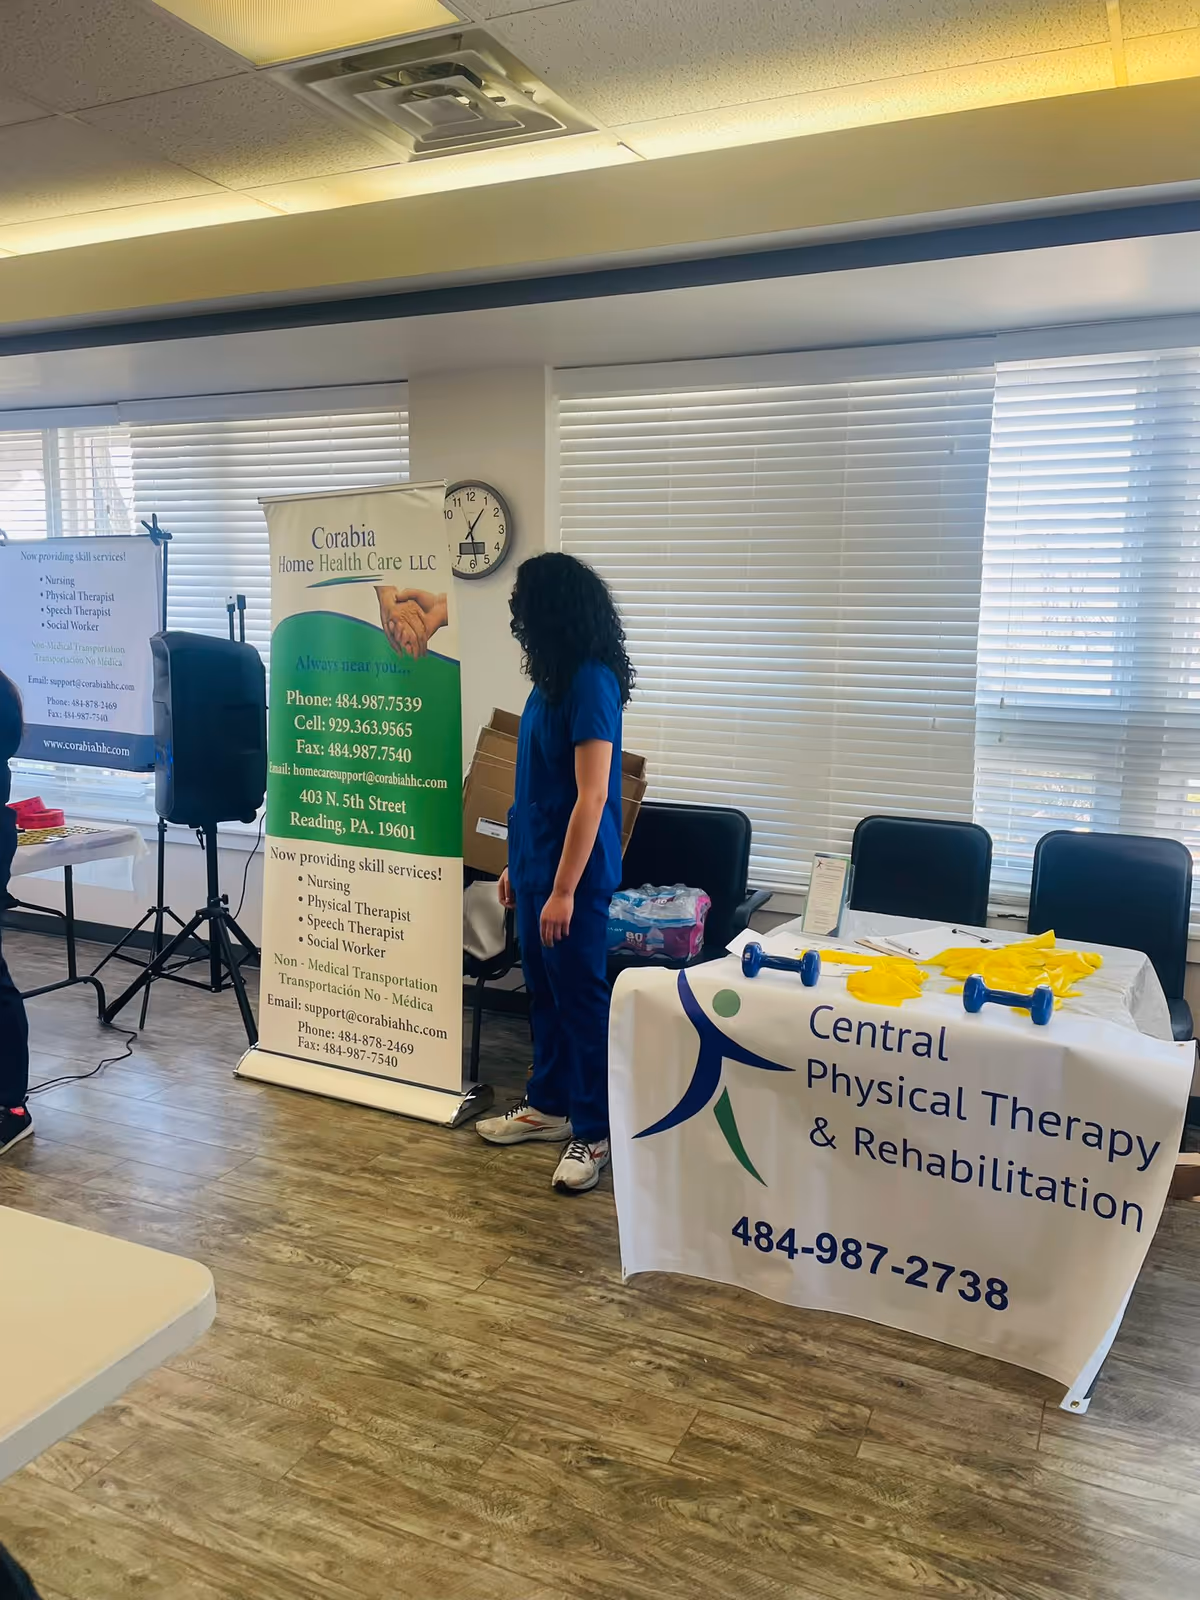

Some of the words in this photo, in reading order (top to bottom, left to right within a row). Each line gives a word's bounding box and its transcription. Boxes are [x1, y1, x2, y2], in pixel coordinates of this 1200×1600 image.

[453, 498, 461, 507] 11
[466, 492, 475, 501] 12
[484, 497, 487, 505] 1
[444, 510, 453, 519] 10
[494, 507, 499, 517] 2
[312, 524, 375, 549] Corabia
[499, 525, 504, 534] 3
[494, 542, 500, 551] 4
[21, 551, 38, 561] Now
[39, 551, 74, 564] providing
[75, 551, 91, 561] skill
[93, 552, 126, 562] services!
[279, 556, 313, 573] Home
[320, 552, 362, 572] Health
[367, 552, 401, 570] Care
[410, 555, 436, 571] LLC
[456, 555, 462, 565] 7
[470, 560, 476, 569] 6
[484, 555, 490, 564] 5
[45, 575, 75, 587] Nursing
[46, 591, 76, 604] Physical
[78, 592, 114, 604] Therapist
[46, 605, 72, 618] Speech
[74, 606, 111, 619] Therapist
[47, 621, 69, 630] Social
[70, 622, 99, 631] Worker
[85, 656, 96, 665] No
[296, 655, 338, 671] Always
[342, 661, 370, 672] near
[28, 675, 49, 685] Email:
[50, 676, 134, 691] support@corabiahhc.com
[47, 696, 70, 706] Phone:
[72, 699, 117, 710] 484-878-2469
[286, 690, 332, 707] Phone:
[335, 694, 422, 712] 484.987.7539
[48, 709, 62, 718] Fax:
[294, 715, 325, 731] Cell:
[329, 718, 412, 737] 929.363.9565
[43, 739, 129, 756] www.corabiahhc.com
[296, 739, 324, 755] Fax:
[328, 742, 411, 763] 484.987.7540
[270, 762, 290, 775] Email:
[293, 763, 447, 789] homecaresupport@corabiahhc.com
[299, 789, 322, 804] 403
[326, 791, 339, 806] N.
[343, 793, 364, 809] 5th
[369, 795, 406, 813] Street
[290, 812, 346, 835] Reading,
[350, 818, 374, 834] PA.
[379, 821, 415, 840] 19601
[271, 846, 296, 861] Now
[300, 852, 355, 873] providing
[359, 858, 384, 873] skill
[388, 866, 442, 881] services!
[307, 874, 350, 895] Nursing
[308, 894, 351, 913] Physical
[355, 902, 411, 922] Therapist
[307, 914, 344, 932] Speech
[348, 920, 404, 941] Therapist
[307, 934, 339, 950] Social
[342, 939, 386, 958] Worker
[274, 953, 297, 967] Non
[308, 958, 349, 977] Medical
[352, 966, 438, 993] Transportation
[279, 972, 360, 998] Transportación
[364, 988, 381, 1002] No
[392, 993, 433, 1012] Médica
[267, 994, 301, 1010] Email:
[304, 1002, 447, 1039] support@corabiahhc.com
[298, 1021, 335, 1039] Phone:
[338, 1030, 414, 1054] 484-878-2469
[809, 1005, 948, 1062] Central
[298, 1036, 320, 1051] Fax:
[323, 1041, 398, 1068] 484-987-7540
[807, 1059, 967, 1121] Physical
[981, 1090, 1161, 1172] Therapy
[809, 1117, 836, 1150] &
[855, 1126, 1144, 1233] Rehabilitation
[731, 1216, 1009, 1311] 484-987-2738
